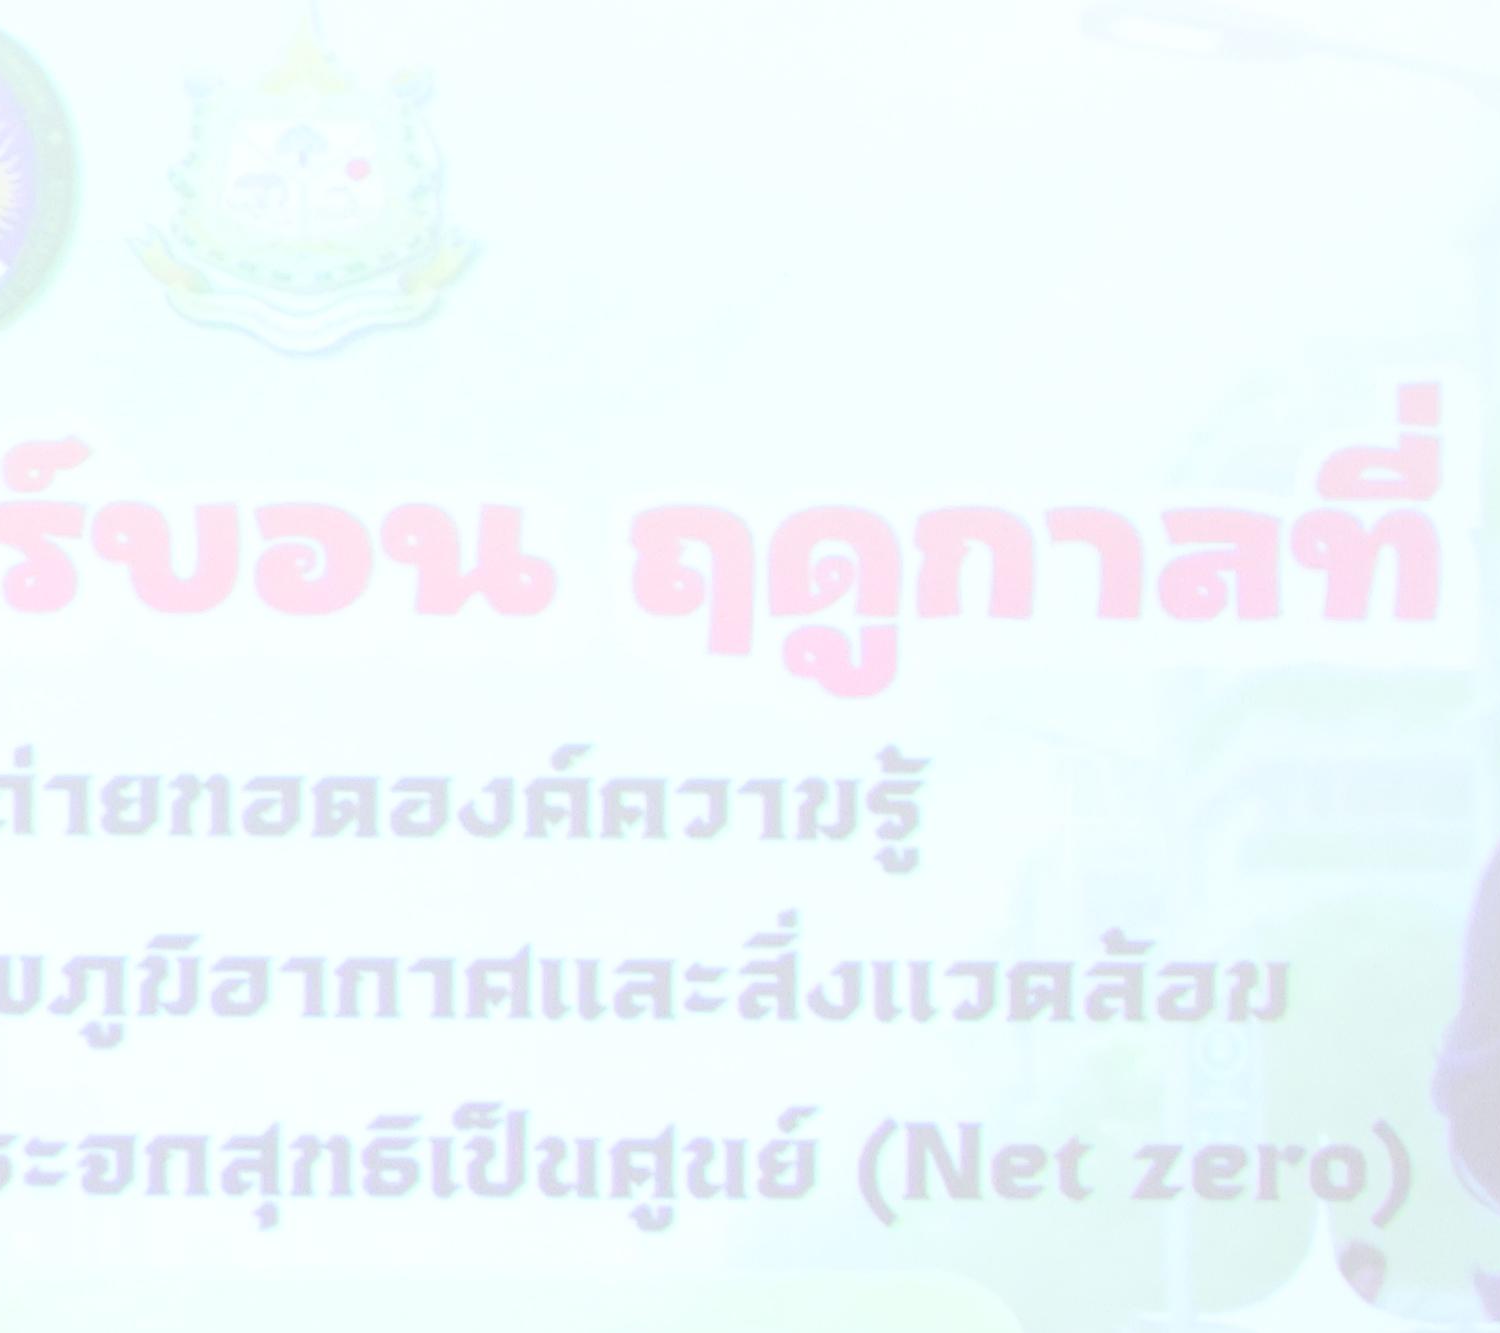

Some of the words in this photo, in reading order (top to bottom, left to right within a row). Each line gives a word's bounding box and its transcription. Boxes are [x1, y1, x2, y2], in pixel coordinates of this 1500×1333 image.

[626, 381, 1442, 699] ฤดูกาลที่
[855, 1116, 1097, 1226] (Net
[1132, 1120, 1414, 1229] zero)
